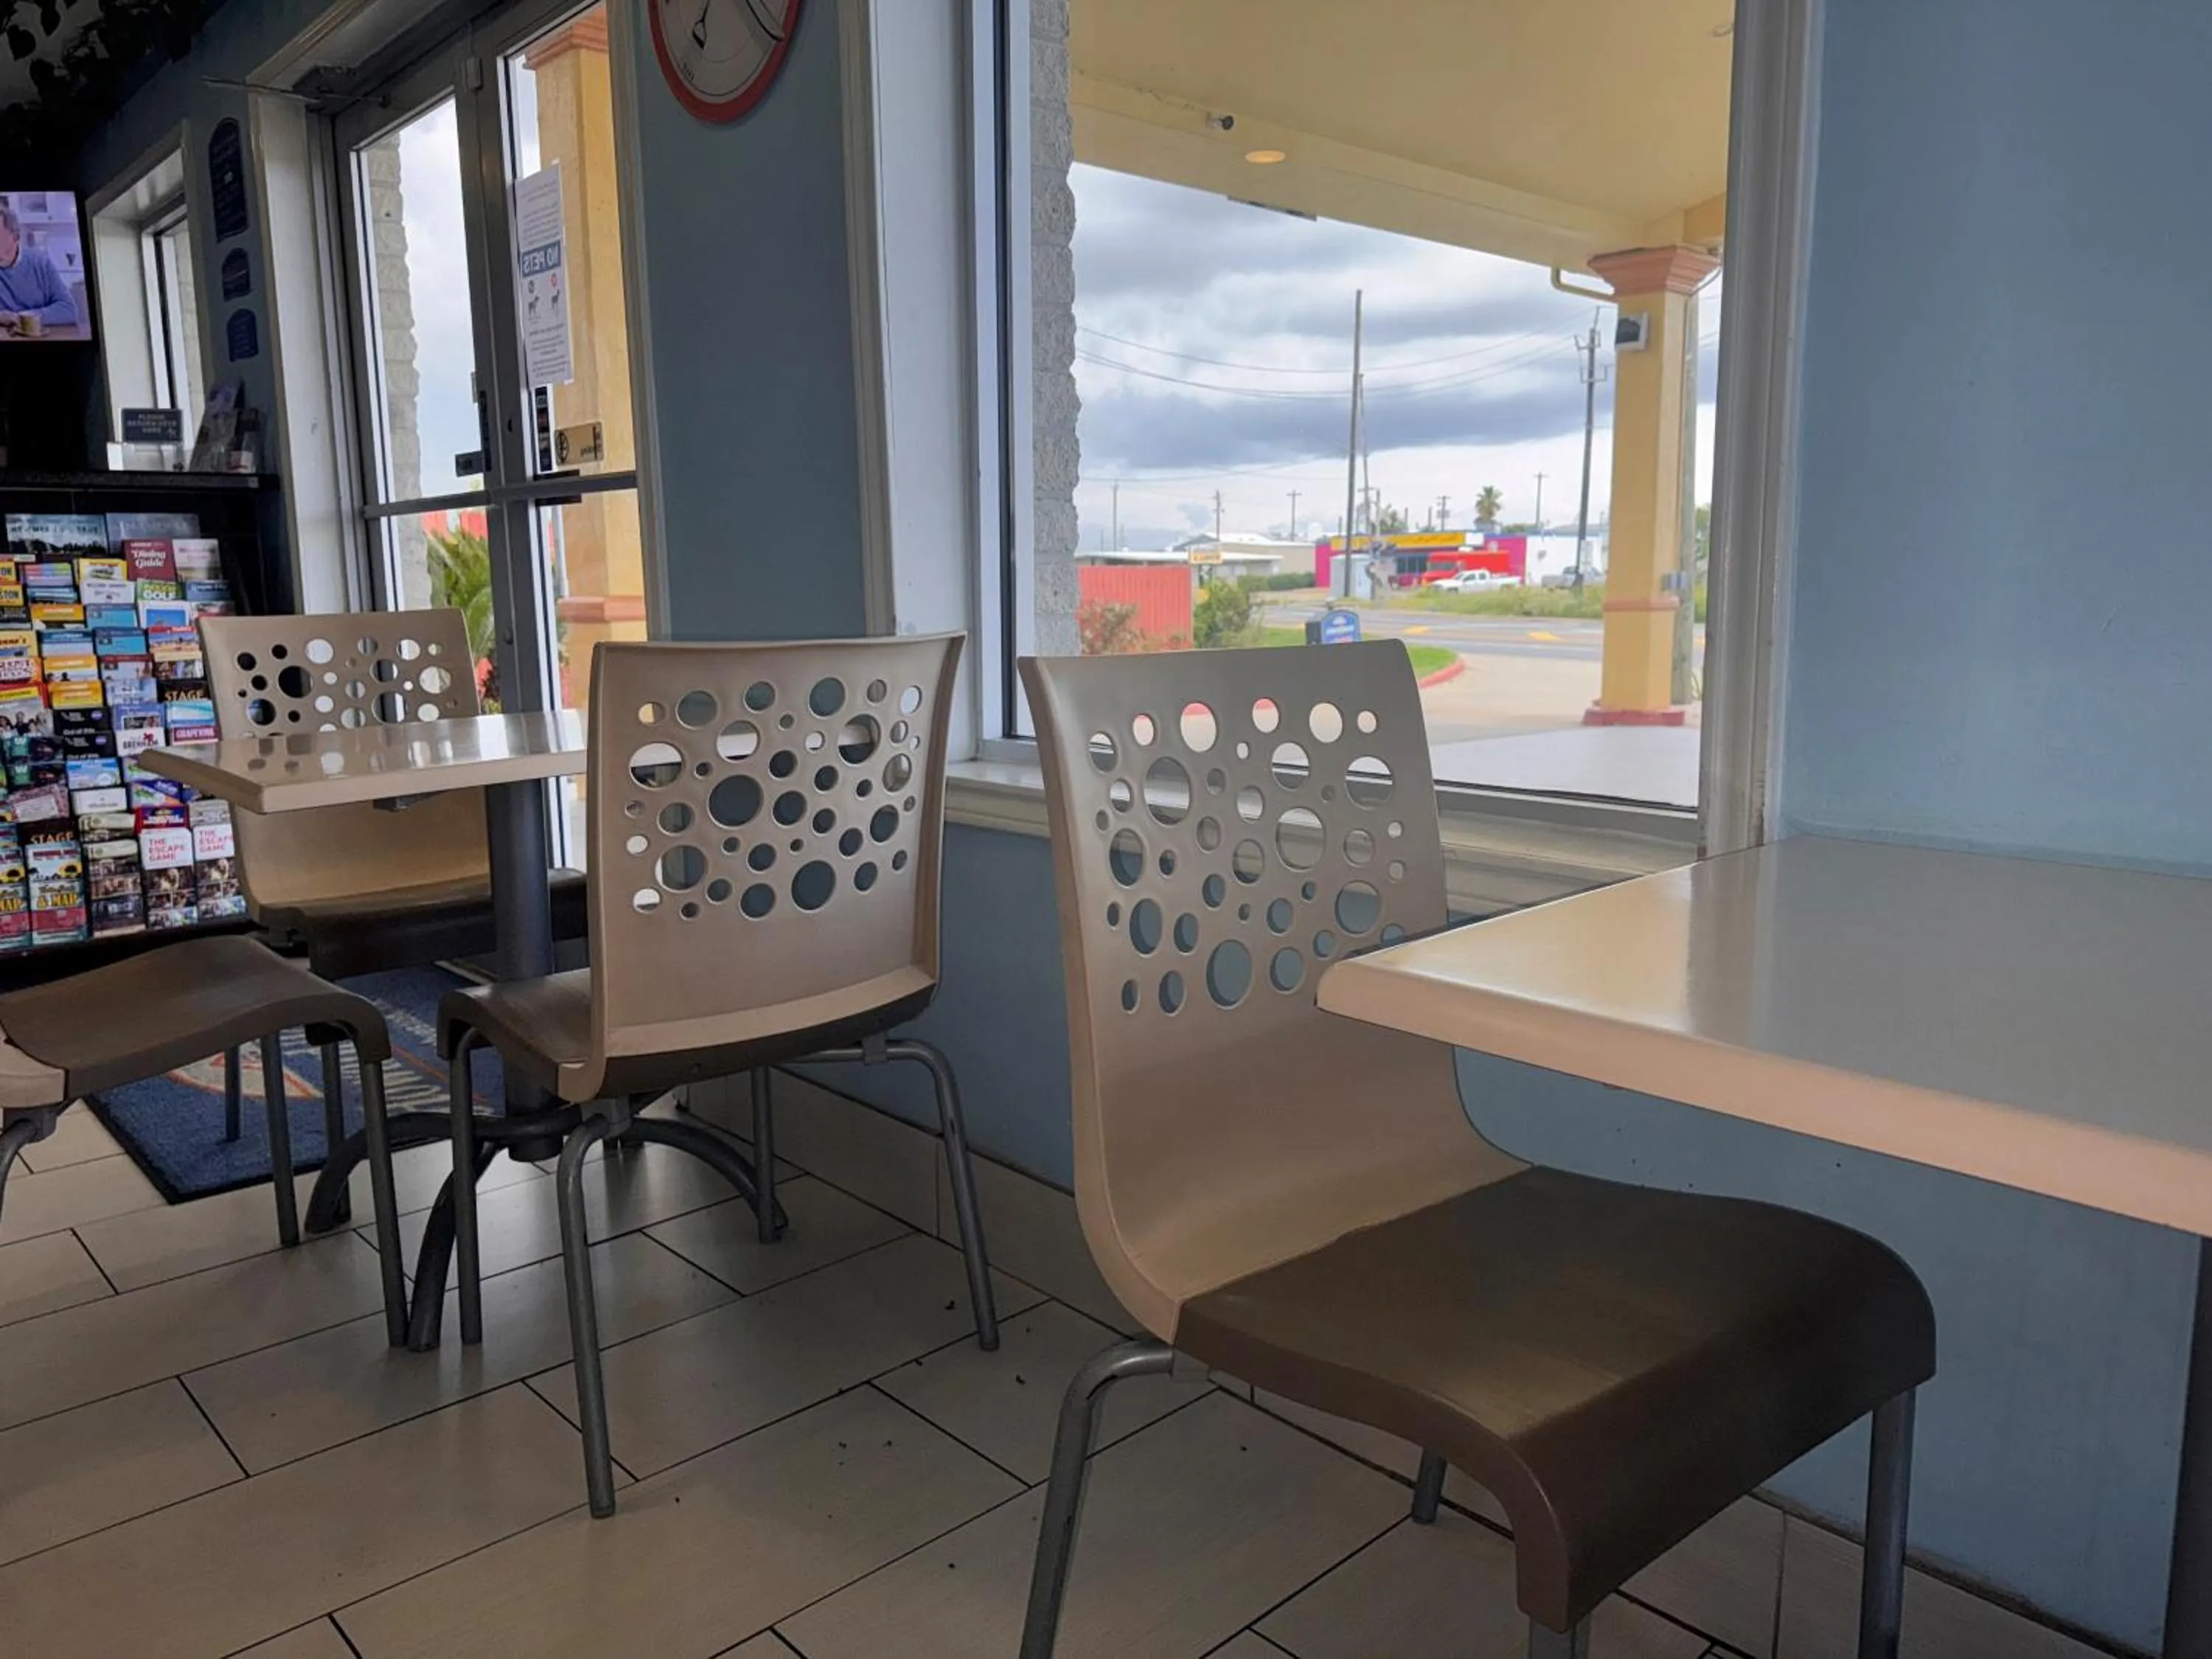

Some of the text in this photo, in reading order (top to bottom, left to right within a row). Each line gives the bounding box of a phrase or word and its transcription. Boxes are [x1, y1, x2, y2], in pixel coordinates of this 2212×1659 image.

[131, 549, 166, 560] Dining
[135, 558, 164, 568] Guide
[142, 591, 176, 600] GOLF
[164, 689, 204, 700] STAGE
[30, 831, 74, 844] STAGE
[149, 838, 165, 846] THE
[149, 845, 184, 854] ESCAPE
[149, 854, 175, 862] GAME
